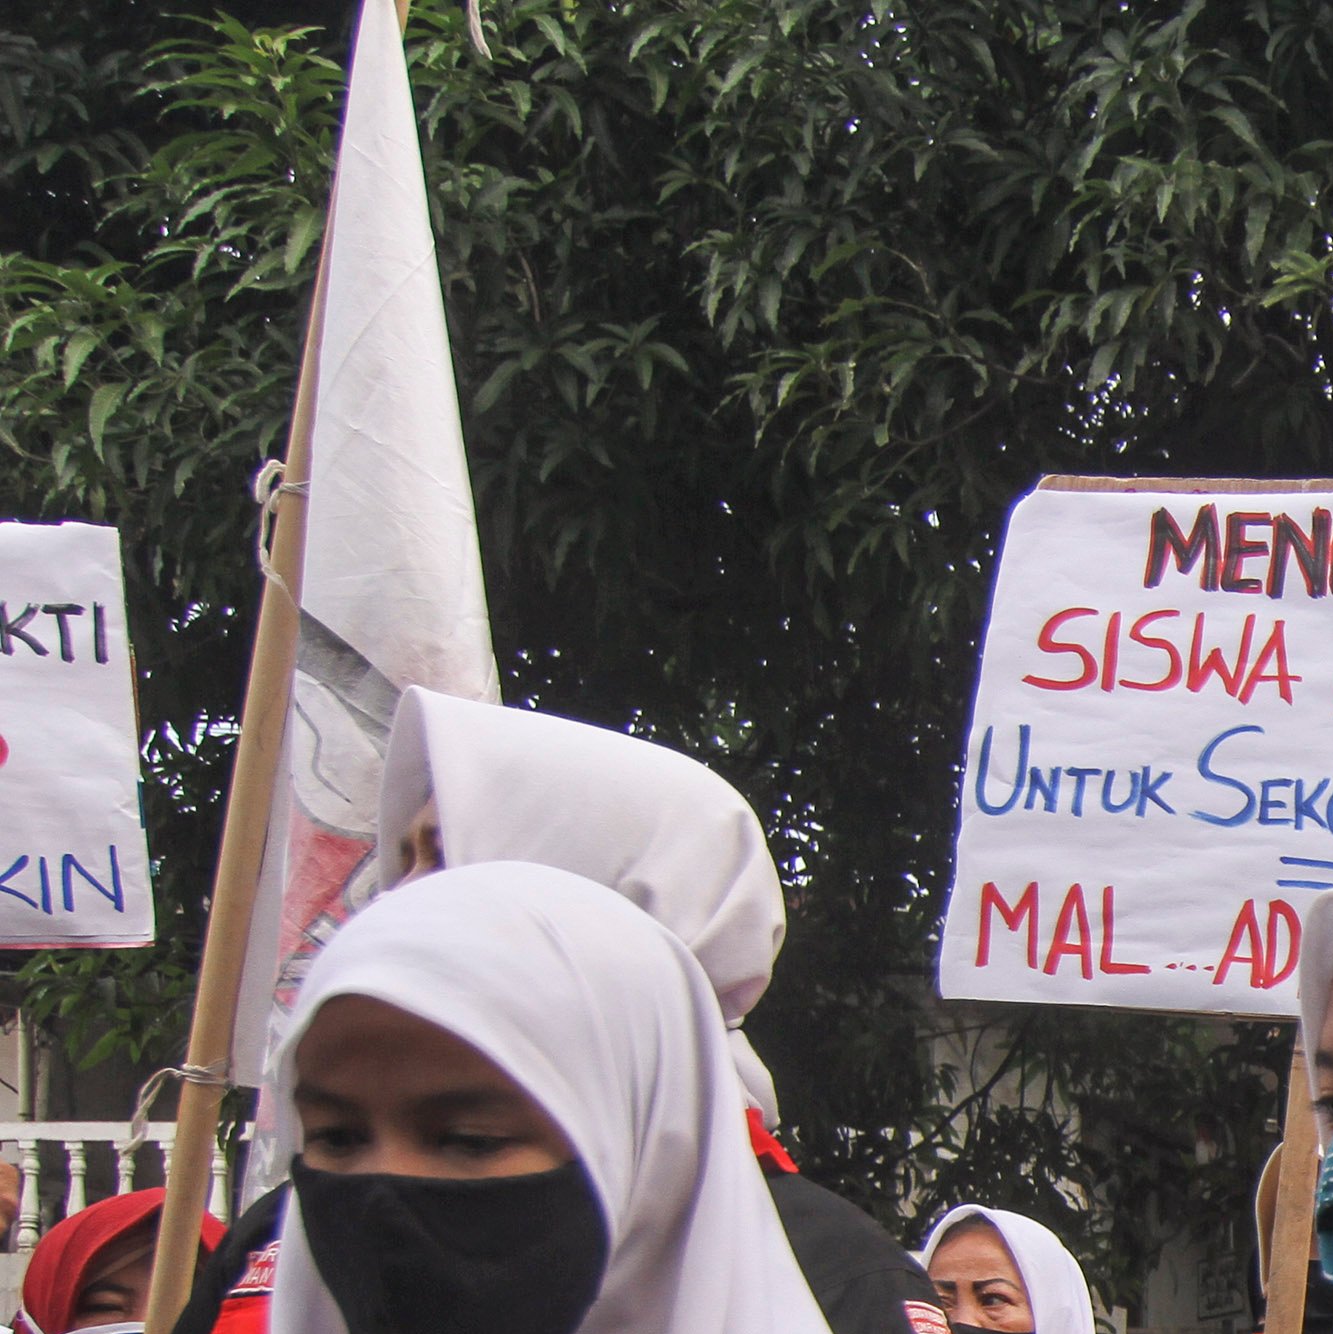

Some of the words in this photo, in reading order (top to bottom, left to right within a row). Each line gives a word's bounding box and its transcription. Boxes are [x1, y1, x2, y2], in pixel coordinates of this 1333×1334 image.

[0, 600, 109, 664] KTI
[1022, 607, 1303, 706] SISWA
[974, 723, 1175, 818] UNTUK
[0, 844, 125, 915] KIN
